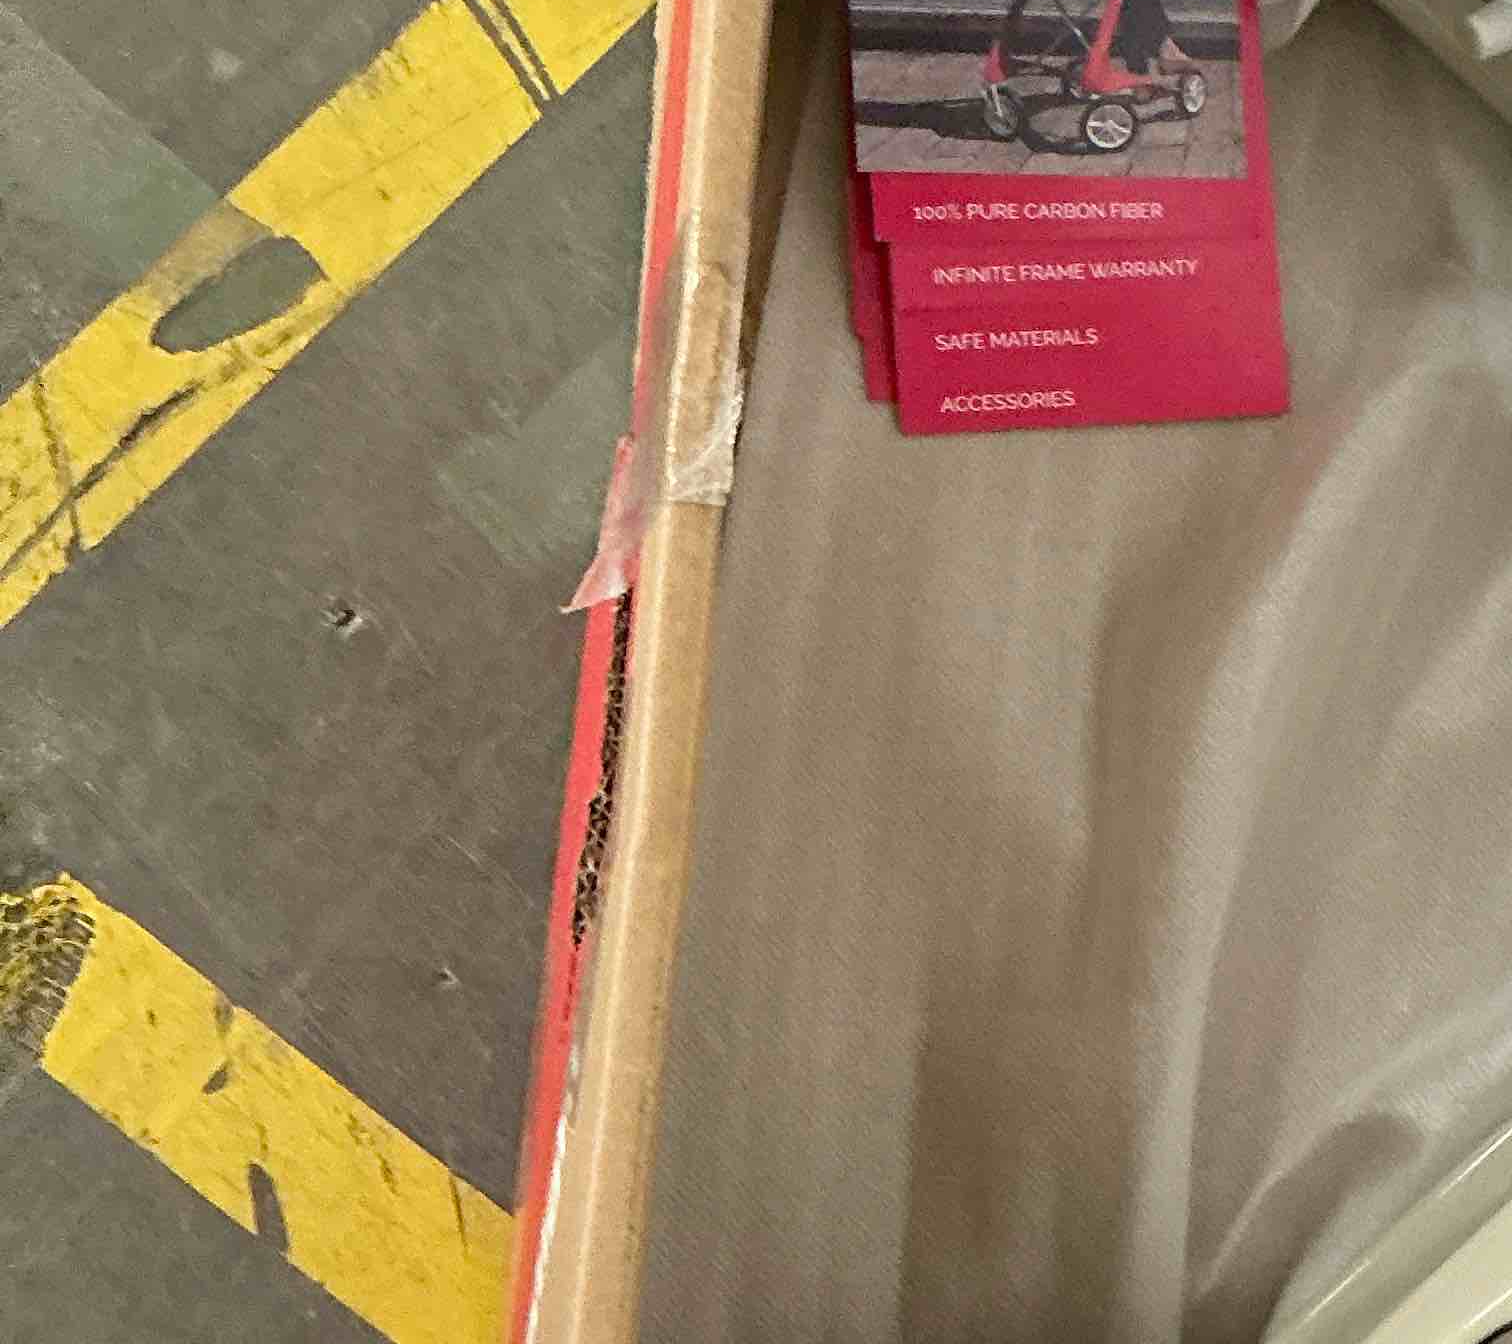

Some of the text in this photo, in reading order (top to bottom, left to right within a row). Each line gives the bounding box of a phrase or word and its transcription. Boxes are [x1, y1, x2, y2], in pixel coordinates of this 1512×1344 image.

[912, 202, 1164, 220] 100% PURE CARBON FIBER
[932, 258, 1199, 285] INFINITE FRAME WARRANTY
[934, 327, 1099, 351] SAFE MATERIALS
[939, 390, 1076, 413] ACCESSORIES
